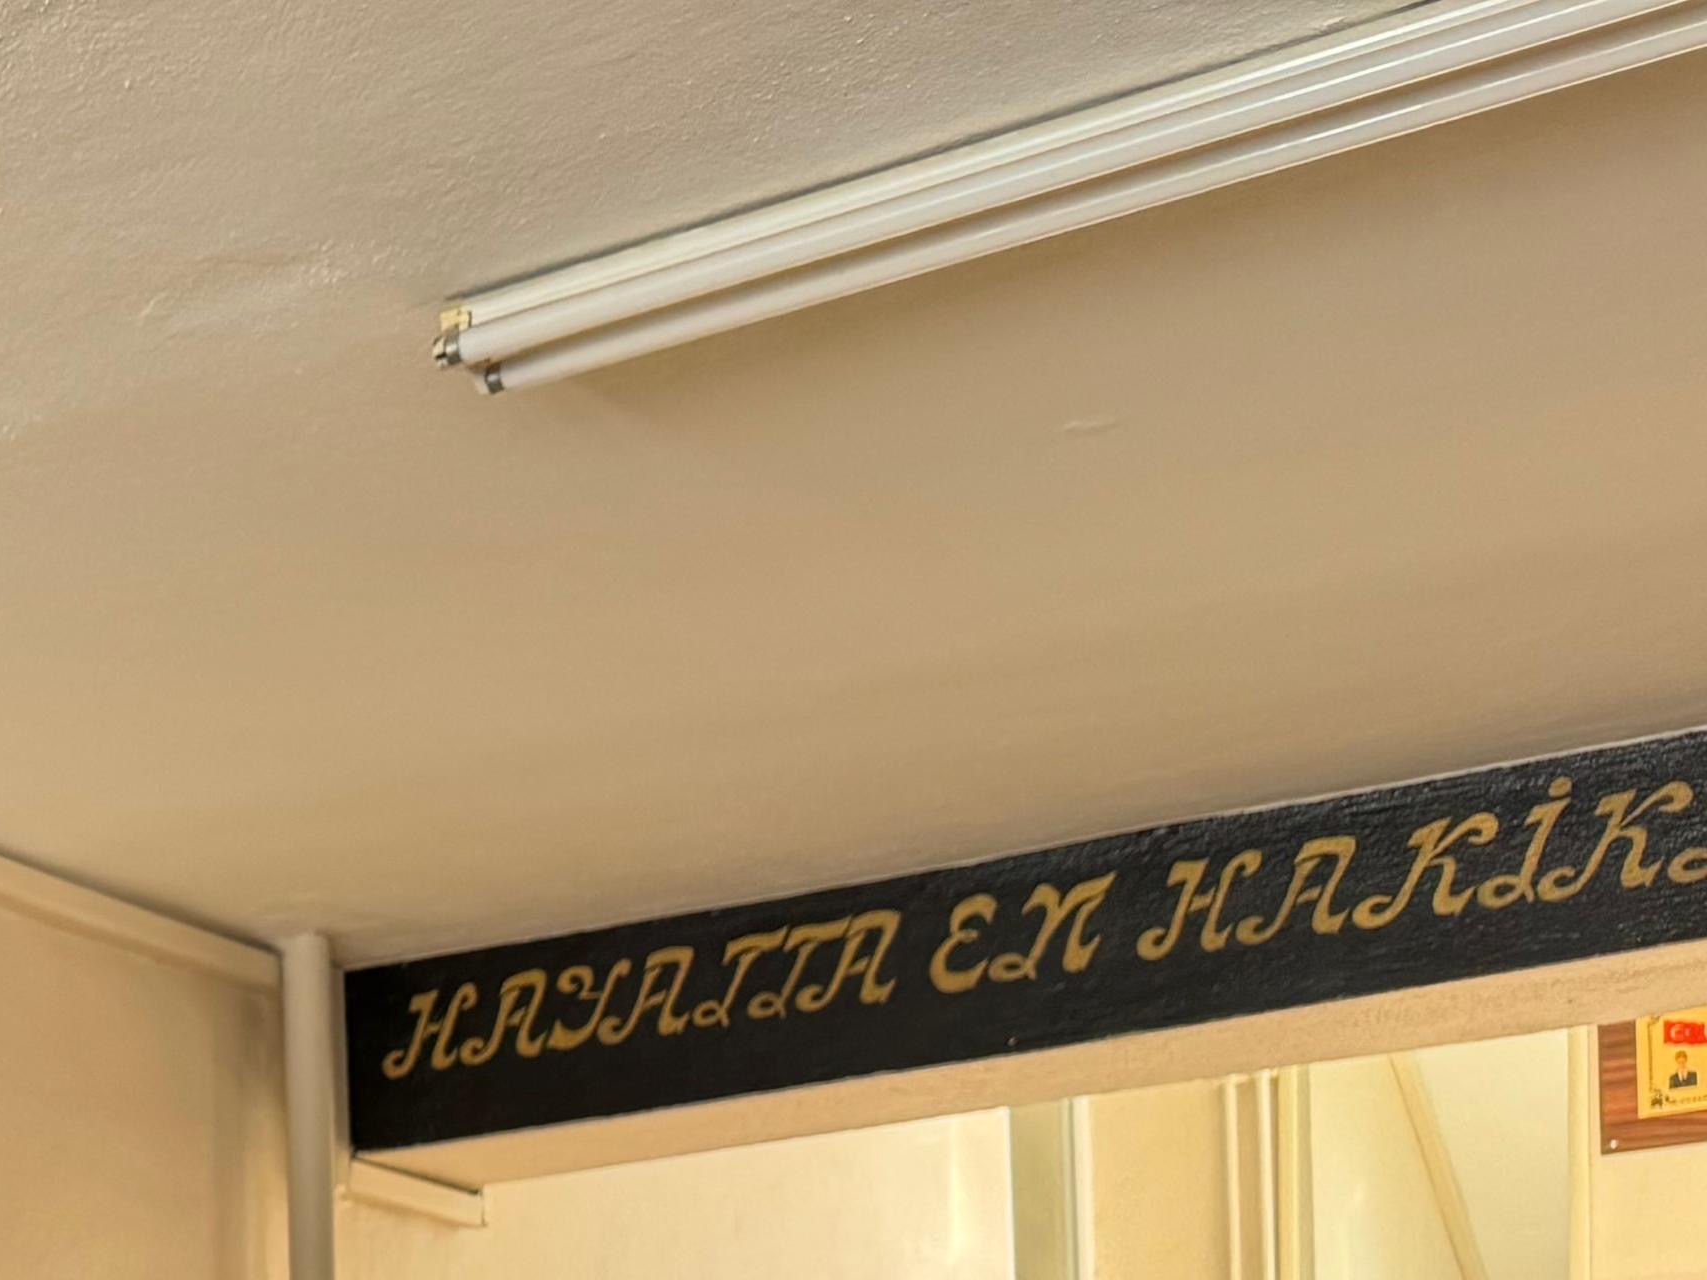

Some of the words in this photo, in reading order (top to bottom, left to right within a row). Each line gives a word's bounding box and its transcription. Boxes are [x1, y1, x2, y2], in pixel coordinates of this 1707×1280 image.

[382, 909, 902, 1079] HAYATTA
[928, 870, 1117, 994] EN
[1136, 776, 1707, 961] HAKİK
